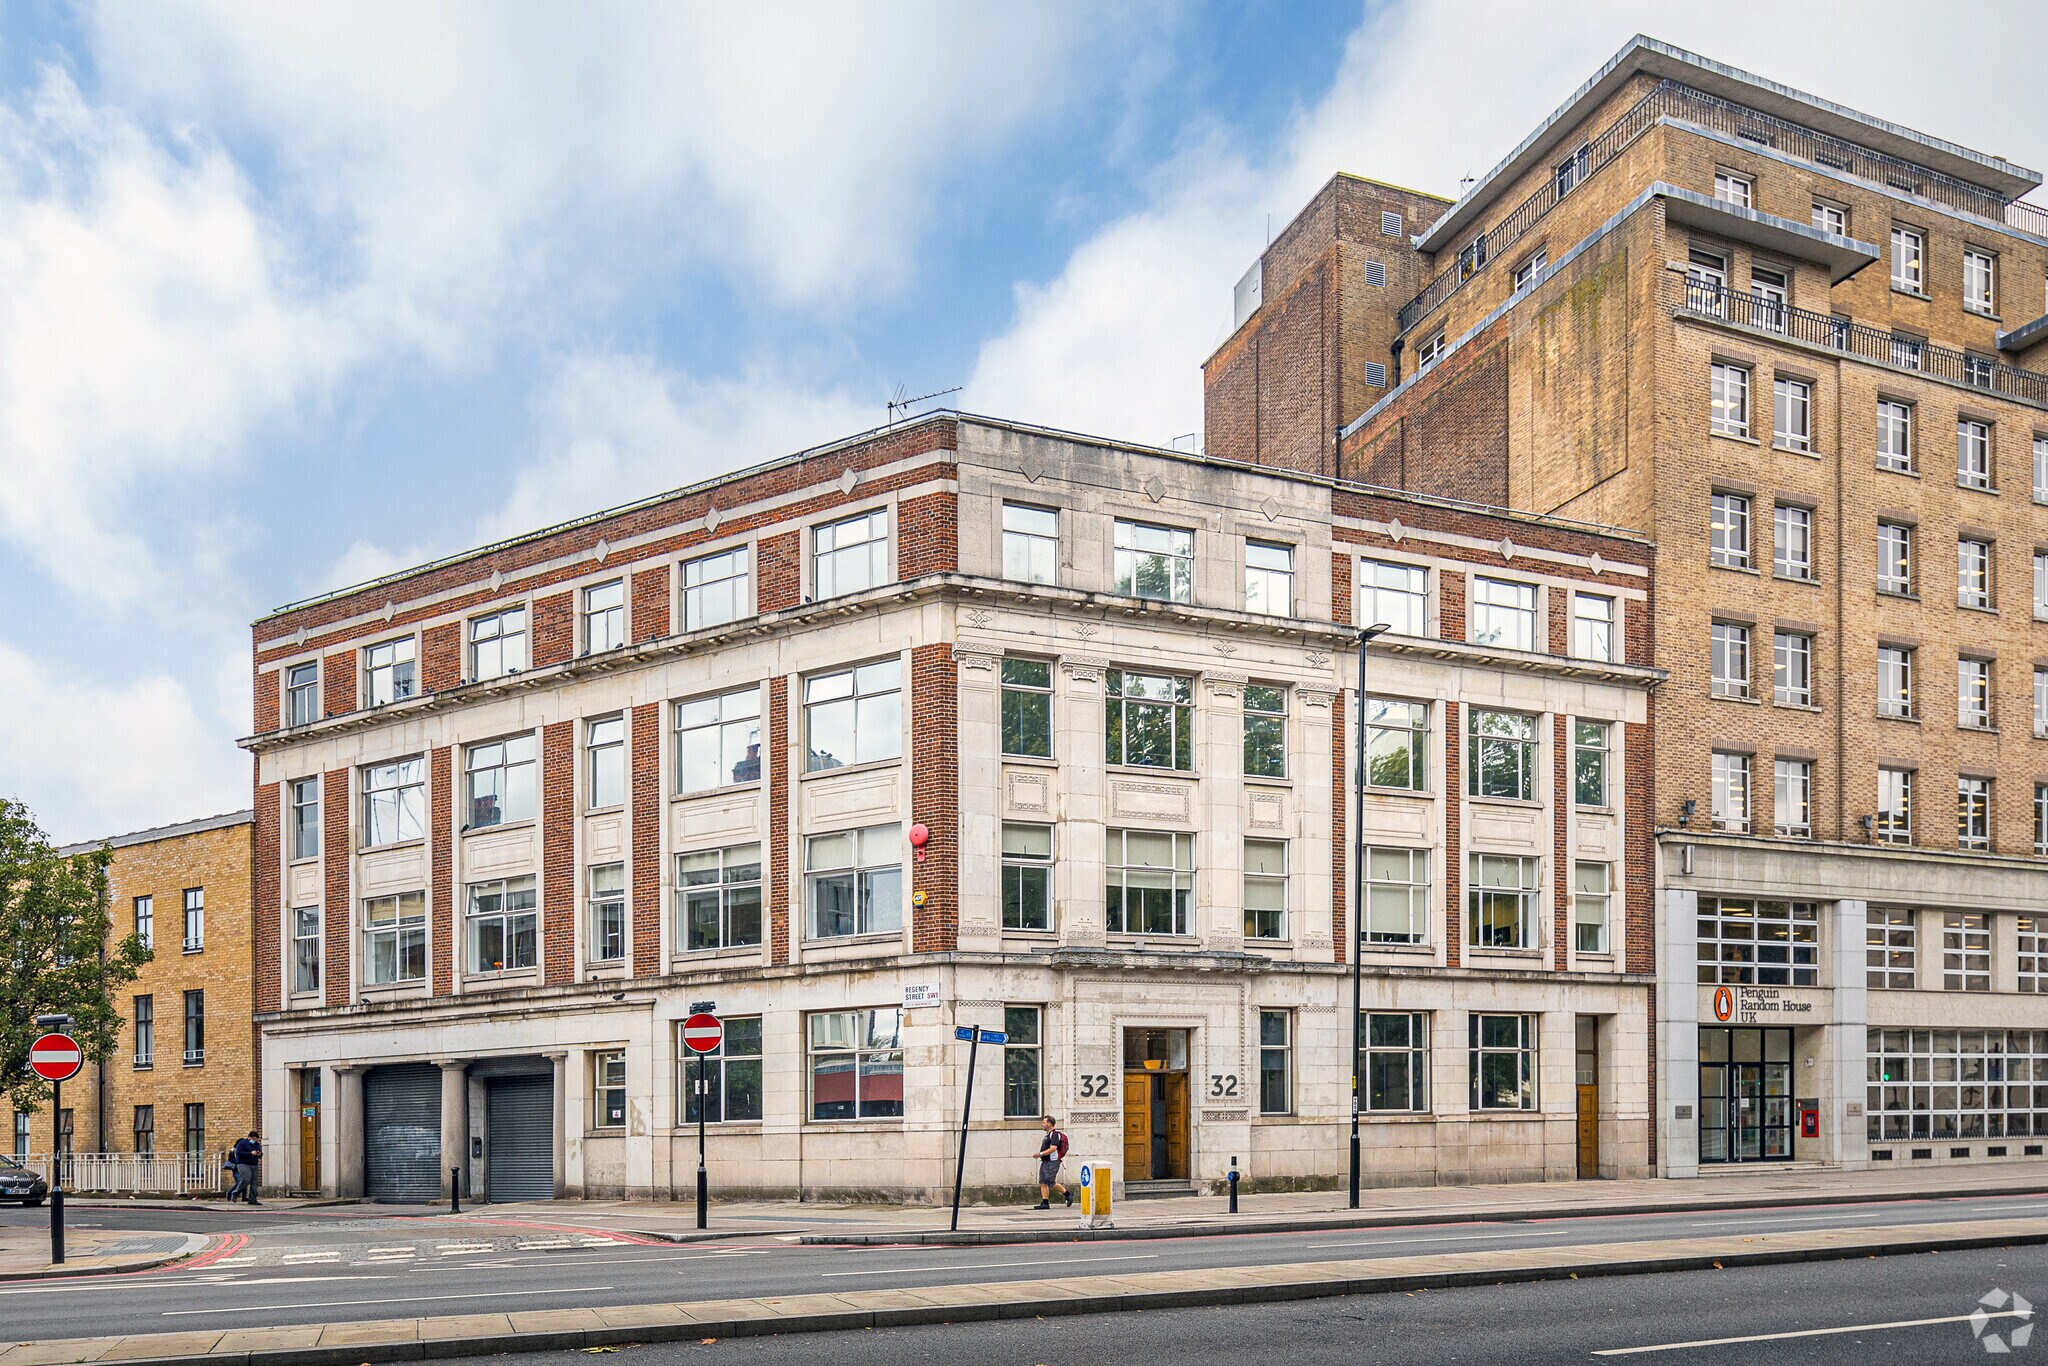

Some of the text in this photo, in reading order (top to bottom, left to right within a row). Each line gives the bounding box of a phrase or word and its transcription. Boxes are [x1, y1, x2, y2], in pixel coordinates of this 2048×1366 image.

[905, 985, 929, 993] REGENCY
[1740, 986, 1779, 1000] Penguin
[1740, 1000, 1812, 1012] Random House
[1741, 1012, 1757, 1022] UK
[1080, 1074, 1109, 1098] 32
[1211, 1074, 1238, 1097] 32
